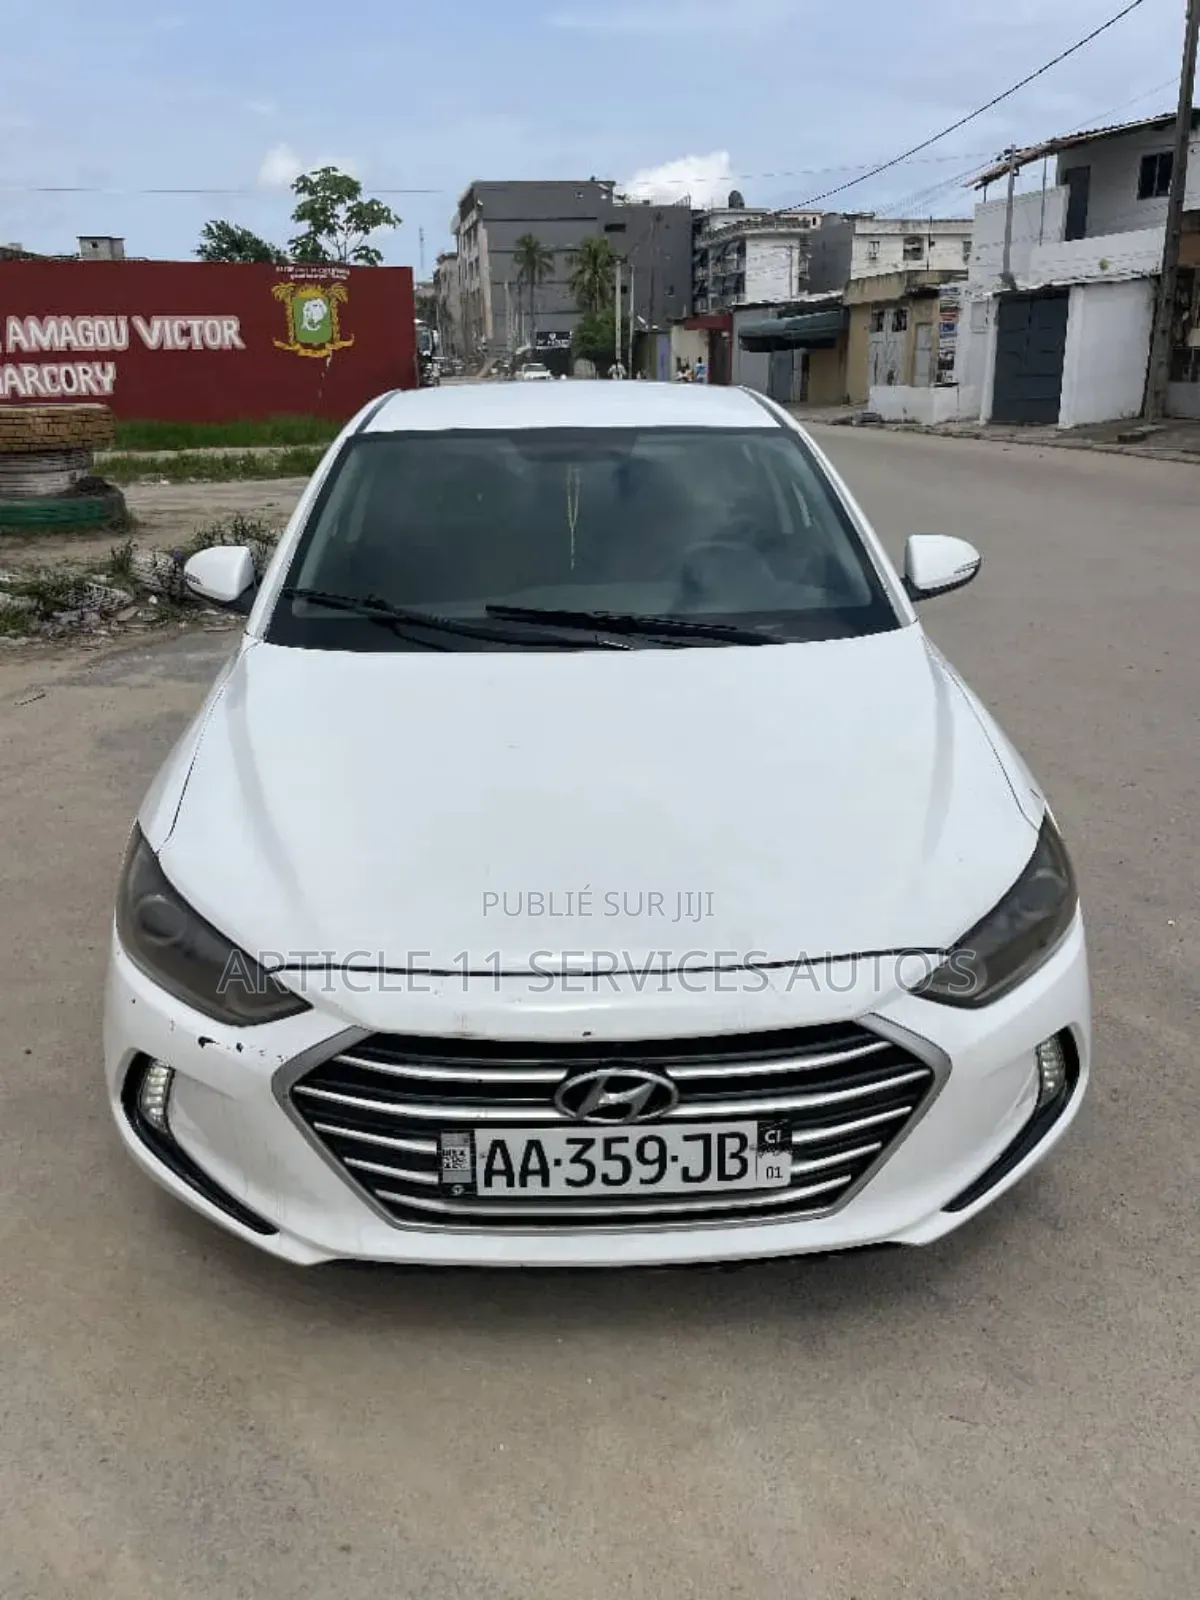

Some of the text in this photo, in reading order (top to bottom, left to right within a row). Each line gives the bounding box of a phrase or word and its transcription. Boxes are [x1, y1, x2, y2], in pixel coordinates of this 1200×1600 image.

[6, 315, 246, 353] AMAGOU VICTOR
[0, 362, 116, 398] ARCORY
[764, 1129, 781, 1144] CI
[766, 1166, 783, 1180] 01
